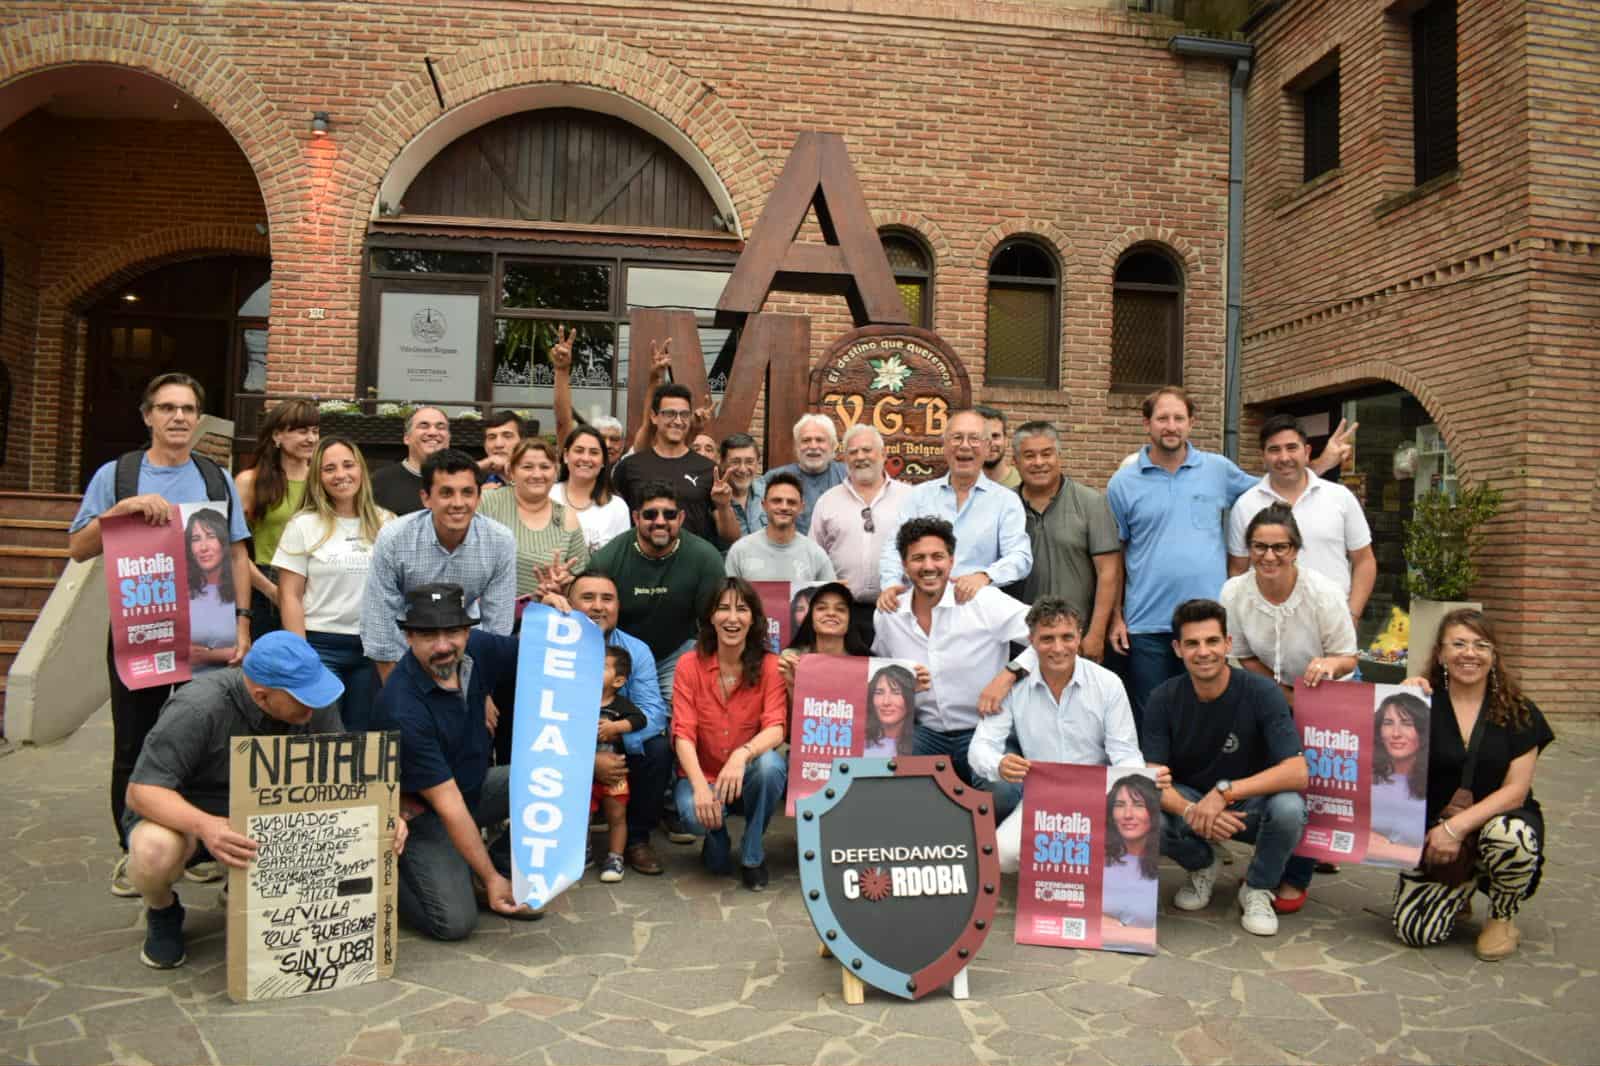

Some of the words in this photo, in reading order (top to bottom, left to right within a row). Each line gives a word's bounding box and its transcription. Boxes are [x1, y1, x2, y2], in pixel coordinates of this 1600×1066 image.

[828, 370, 841, 384] El
[838, 340, 877, 369] destino
[880, 340, 904, 350] que
[906, 342, 953, 386] queremos
[117, 552, 175, 578] Natalia
[120, 578, 177, 609] Sota
[803, 697, 854, 719] Natalia
[802, 718, 852, 748] Sota
[1304, 726, 1359, 751] Natalia
[1305, 748, 1358, 783] Sota
[1310, 777, 1357, 791] IPUTADA
[1034, 810, 1091, 834] Natalia
[831, 844, 968, 864] DEFENDAMOS
[1034, 833, 1090, 865] Sota
[1032, 863, 1089, 875] DIPUTADA
